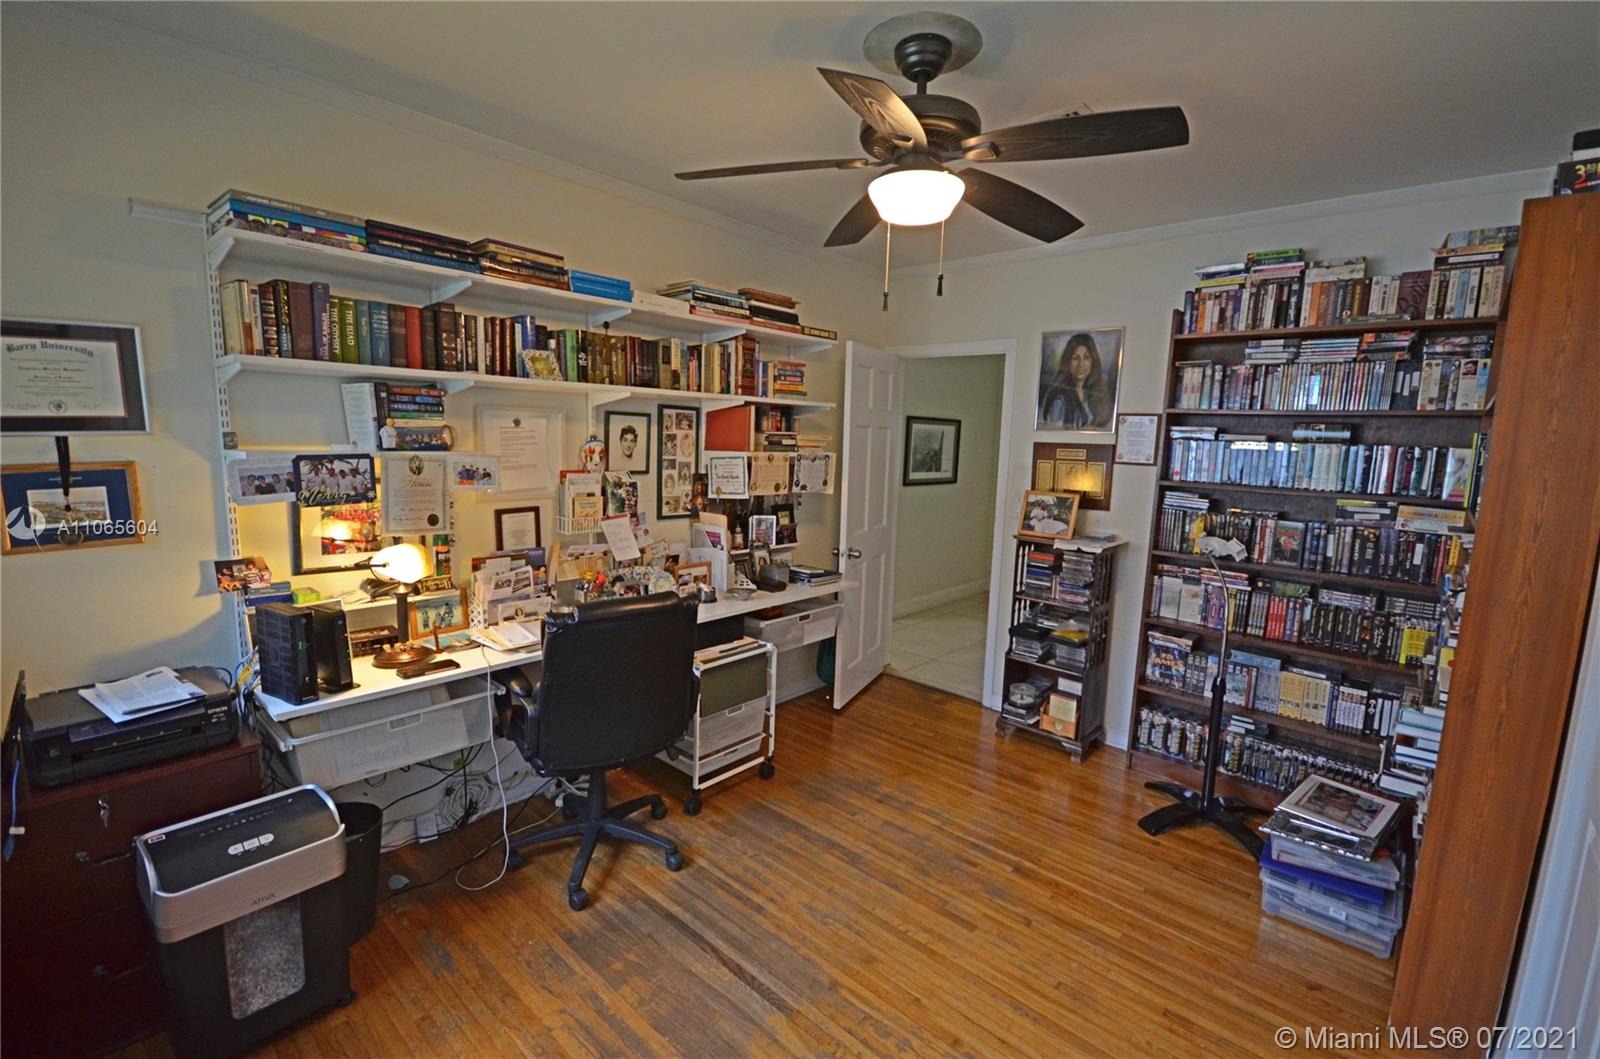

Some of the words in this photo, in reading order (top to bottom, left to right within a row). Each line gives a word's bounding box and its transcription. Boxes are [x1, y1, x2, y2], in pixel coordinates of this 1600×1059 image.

[330, 308, 338, 322] THE
[345, 310, 353, 323] THE
[331, 323, 340, 354] ODYSSEY
[347, 325, 355, 346] ILIAD
[5, 343, 37, 353] Barry
[39, 340, 94, 358] University
[207, 705, 228, 715] EPSON
